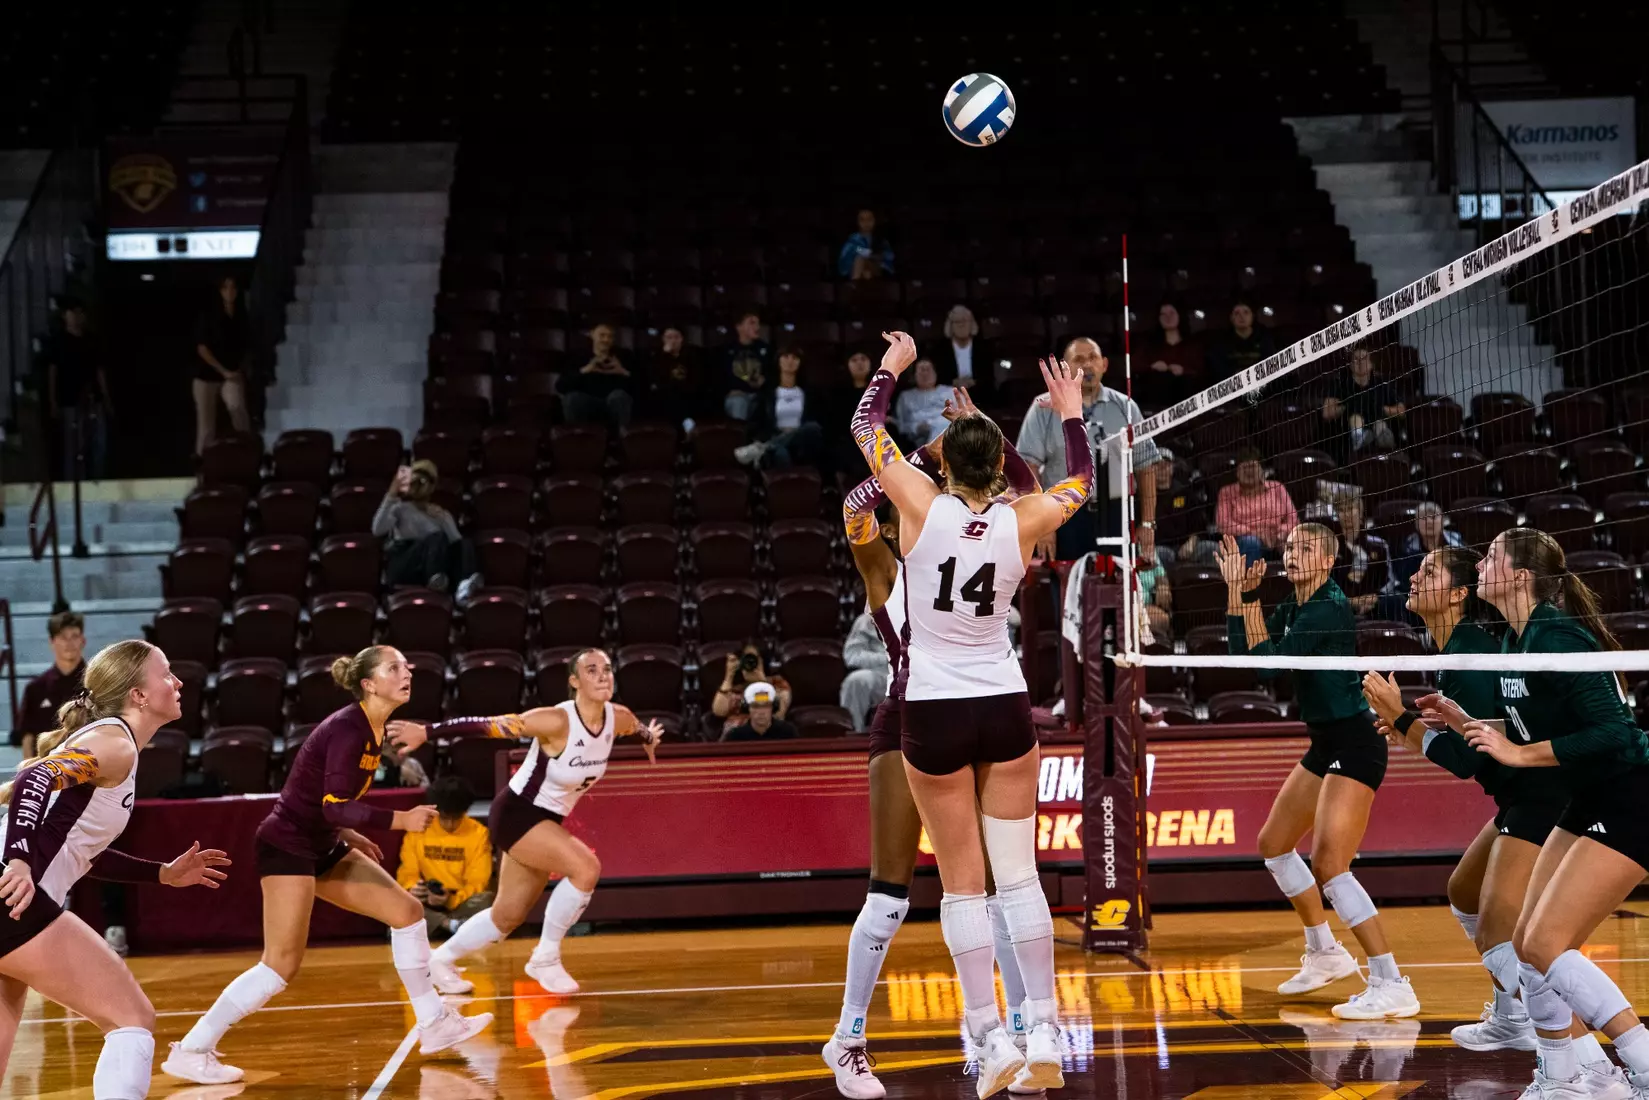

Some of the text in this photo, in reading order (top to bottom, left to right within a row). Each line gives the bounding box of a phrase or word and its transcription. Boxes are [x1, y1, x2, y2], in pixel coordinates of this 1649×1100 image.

[1507, 123, 1619, 145] Karmanos
[843, 477, 884, 518] CHIPPE
[933, 556, 996, 617] 14
[1500, 676, 1530, 698] STERN
[575, 776, 597, 792] 5
[1101, 796, 1117, 889] sports imports
